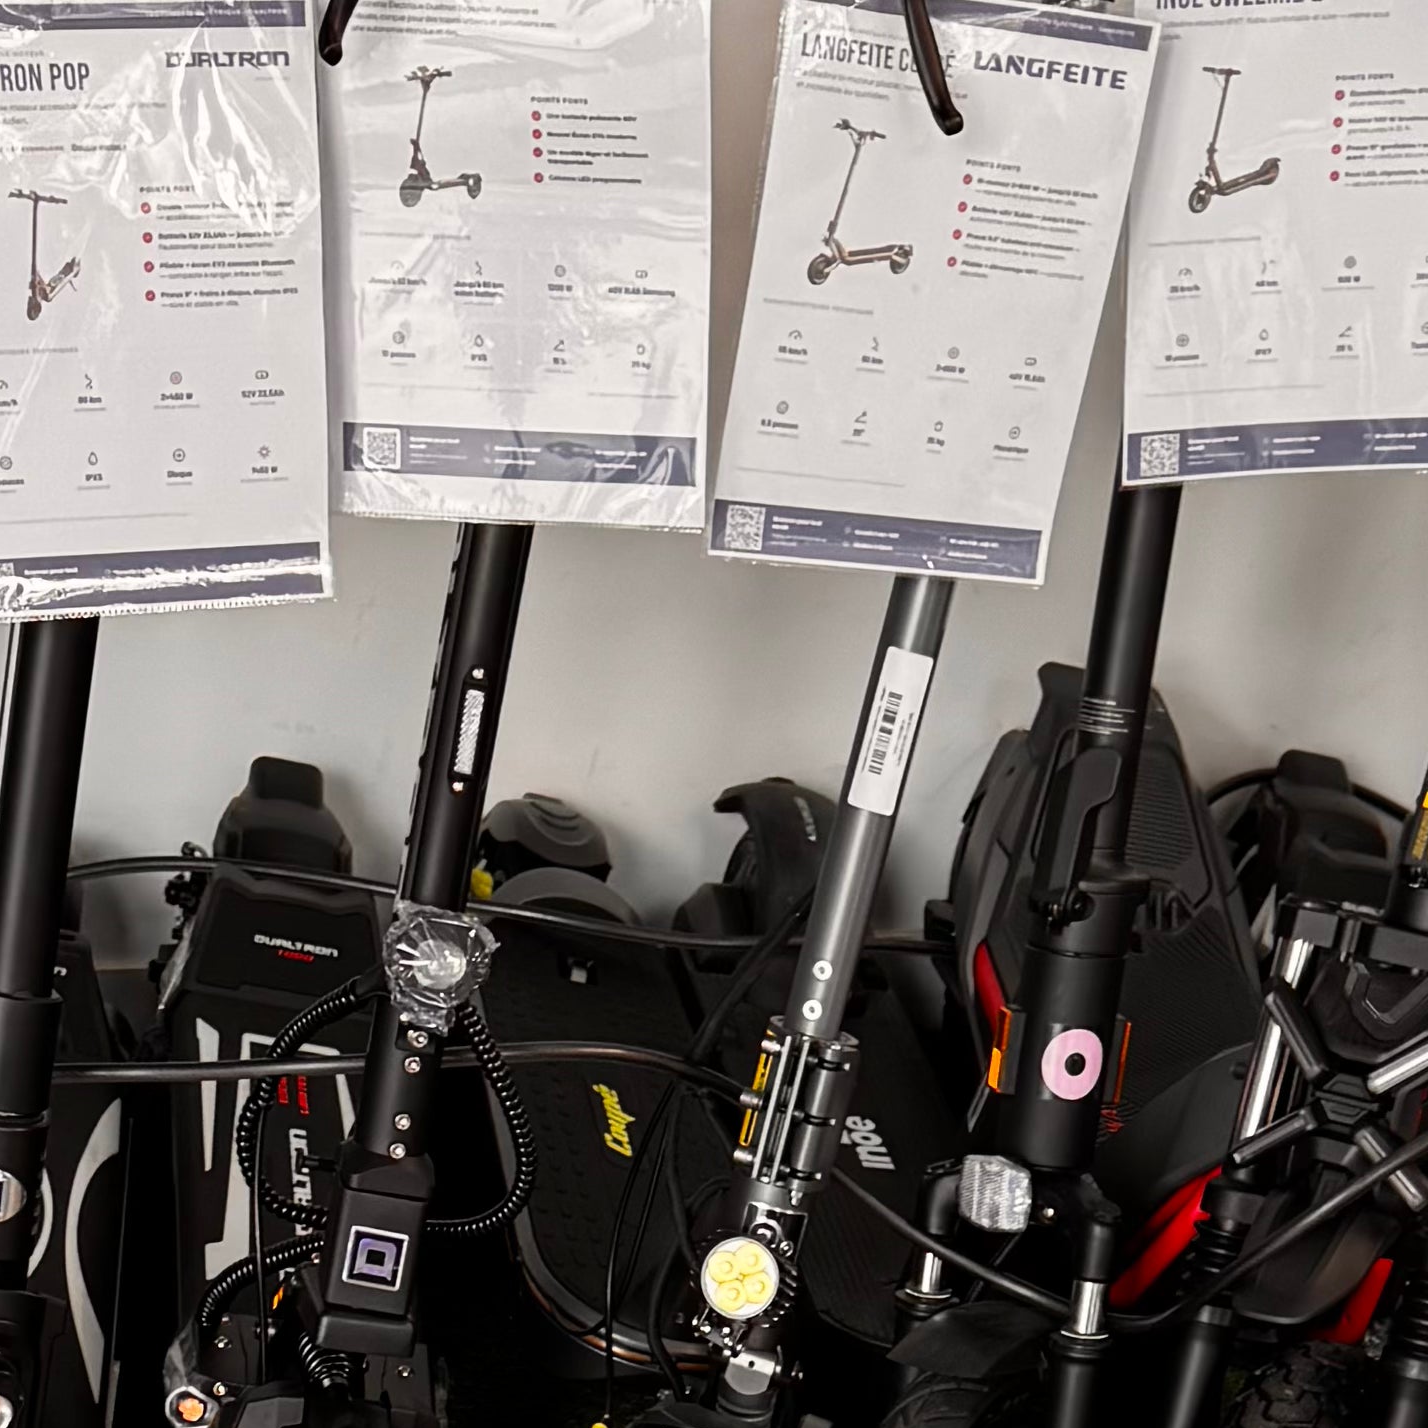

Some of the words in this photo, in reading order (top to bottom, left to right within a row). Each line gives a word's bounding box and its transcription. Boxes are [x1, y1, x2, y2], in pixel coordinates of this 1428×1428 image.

[801, 32, 895, 71] LANGFEITE
[50, 62, 91, 92] POP
[973, 50, 1128, 90] LANGFEITE
[254, 934, 339, 957] DUALTRON
